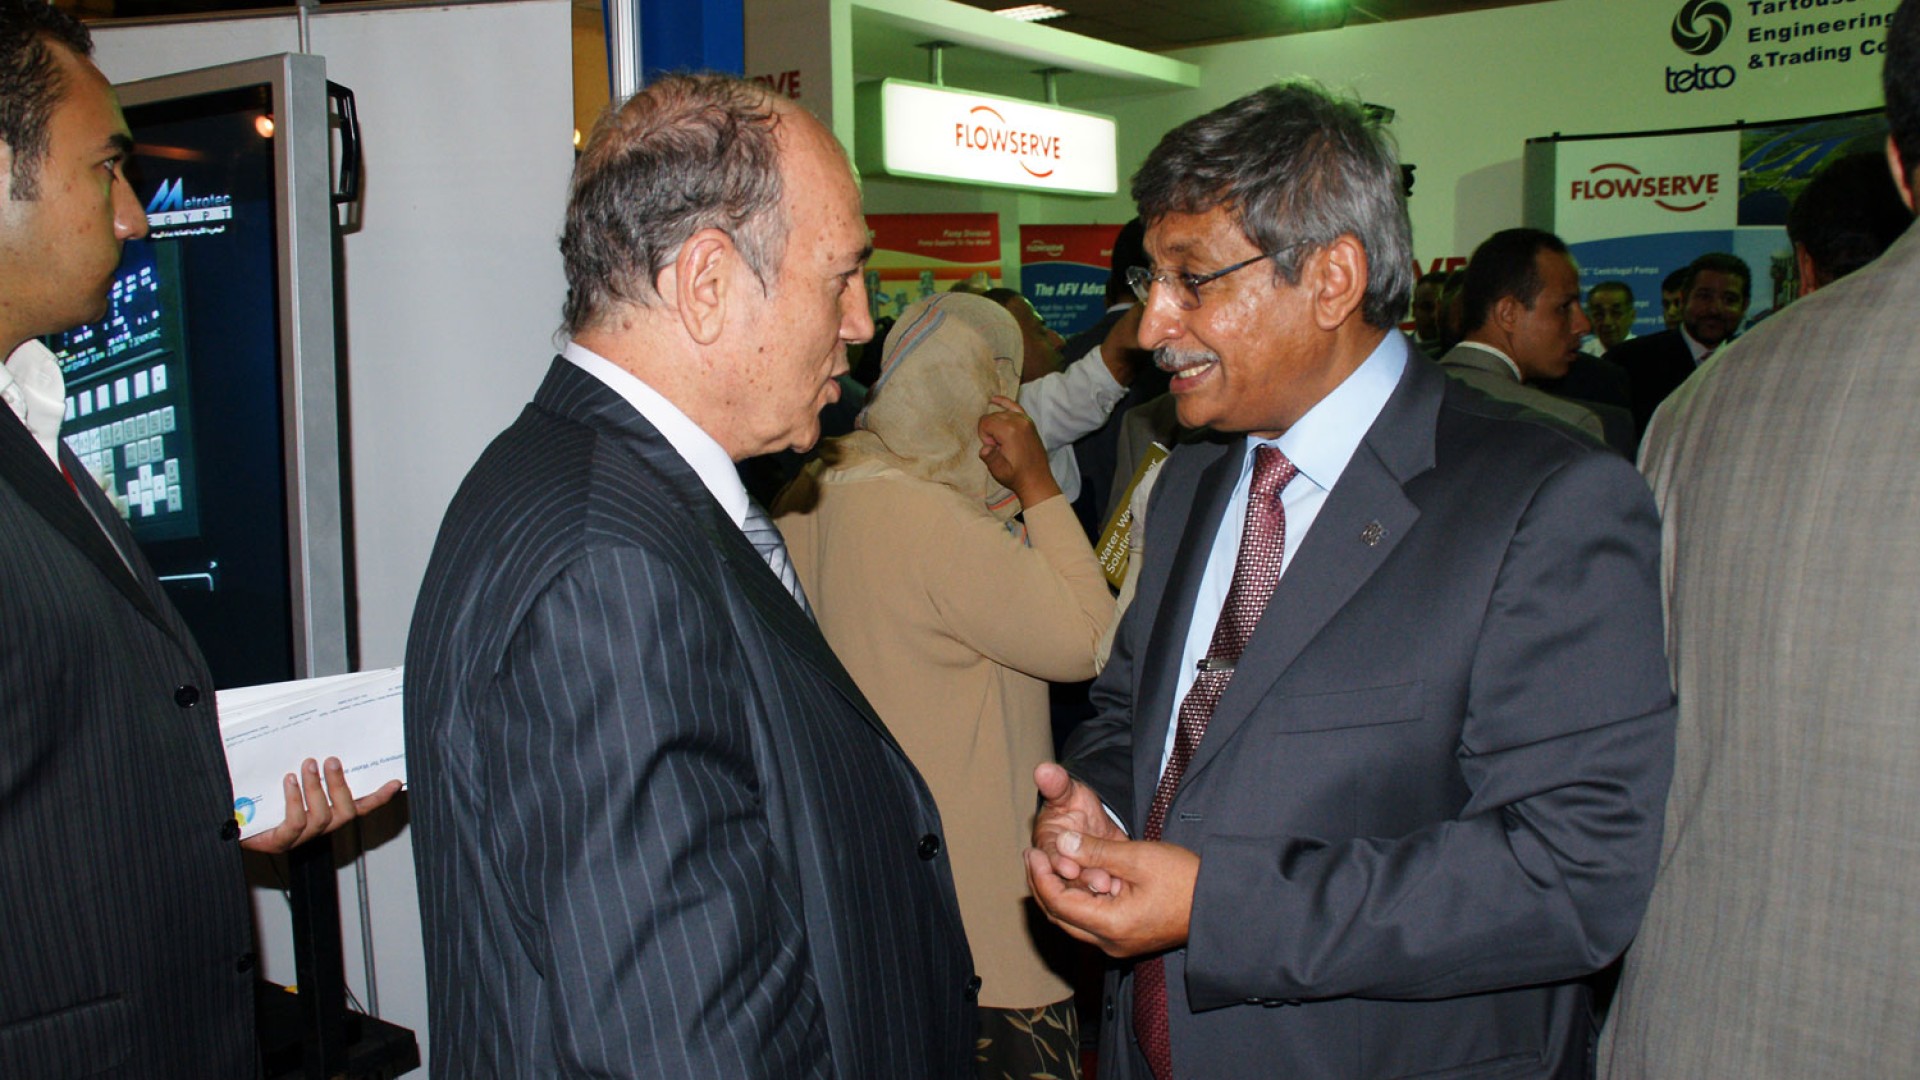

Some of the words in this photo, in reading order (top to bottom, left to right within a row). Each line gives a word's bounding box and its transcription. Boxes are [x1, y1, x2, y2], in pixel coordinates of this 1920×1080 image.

[1748, 46, 1852, 70] &Trading
[1666, 63, 1736, 94] tetco
[955, 122, 1061, 160] FLOWSERVE
[147, 177, 231, 212] Metrotec
[1570, 173, 1720, 201] FLOWSERVE
[1034, 282, 1055, 296] The
[1055, 281, 1080, 296] AFV
[1099, 530, 1121, 566] Water
